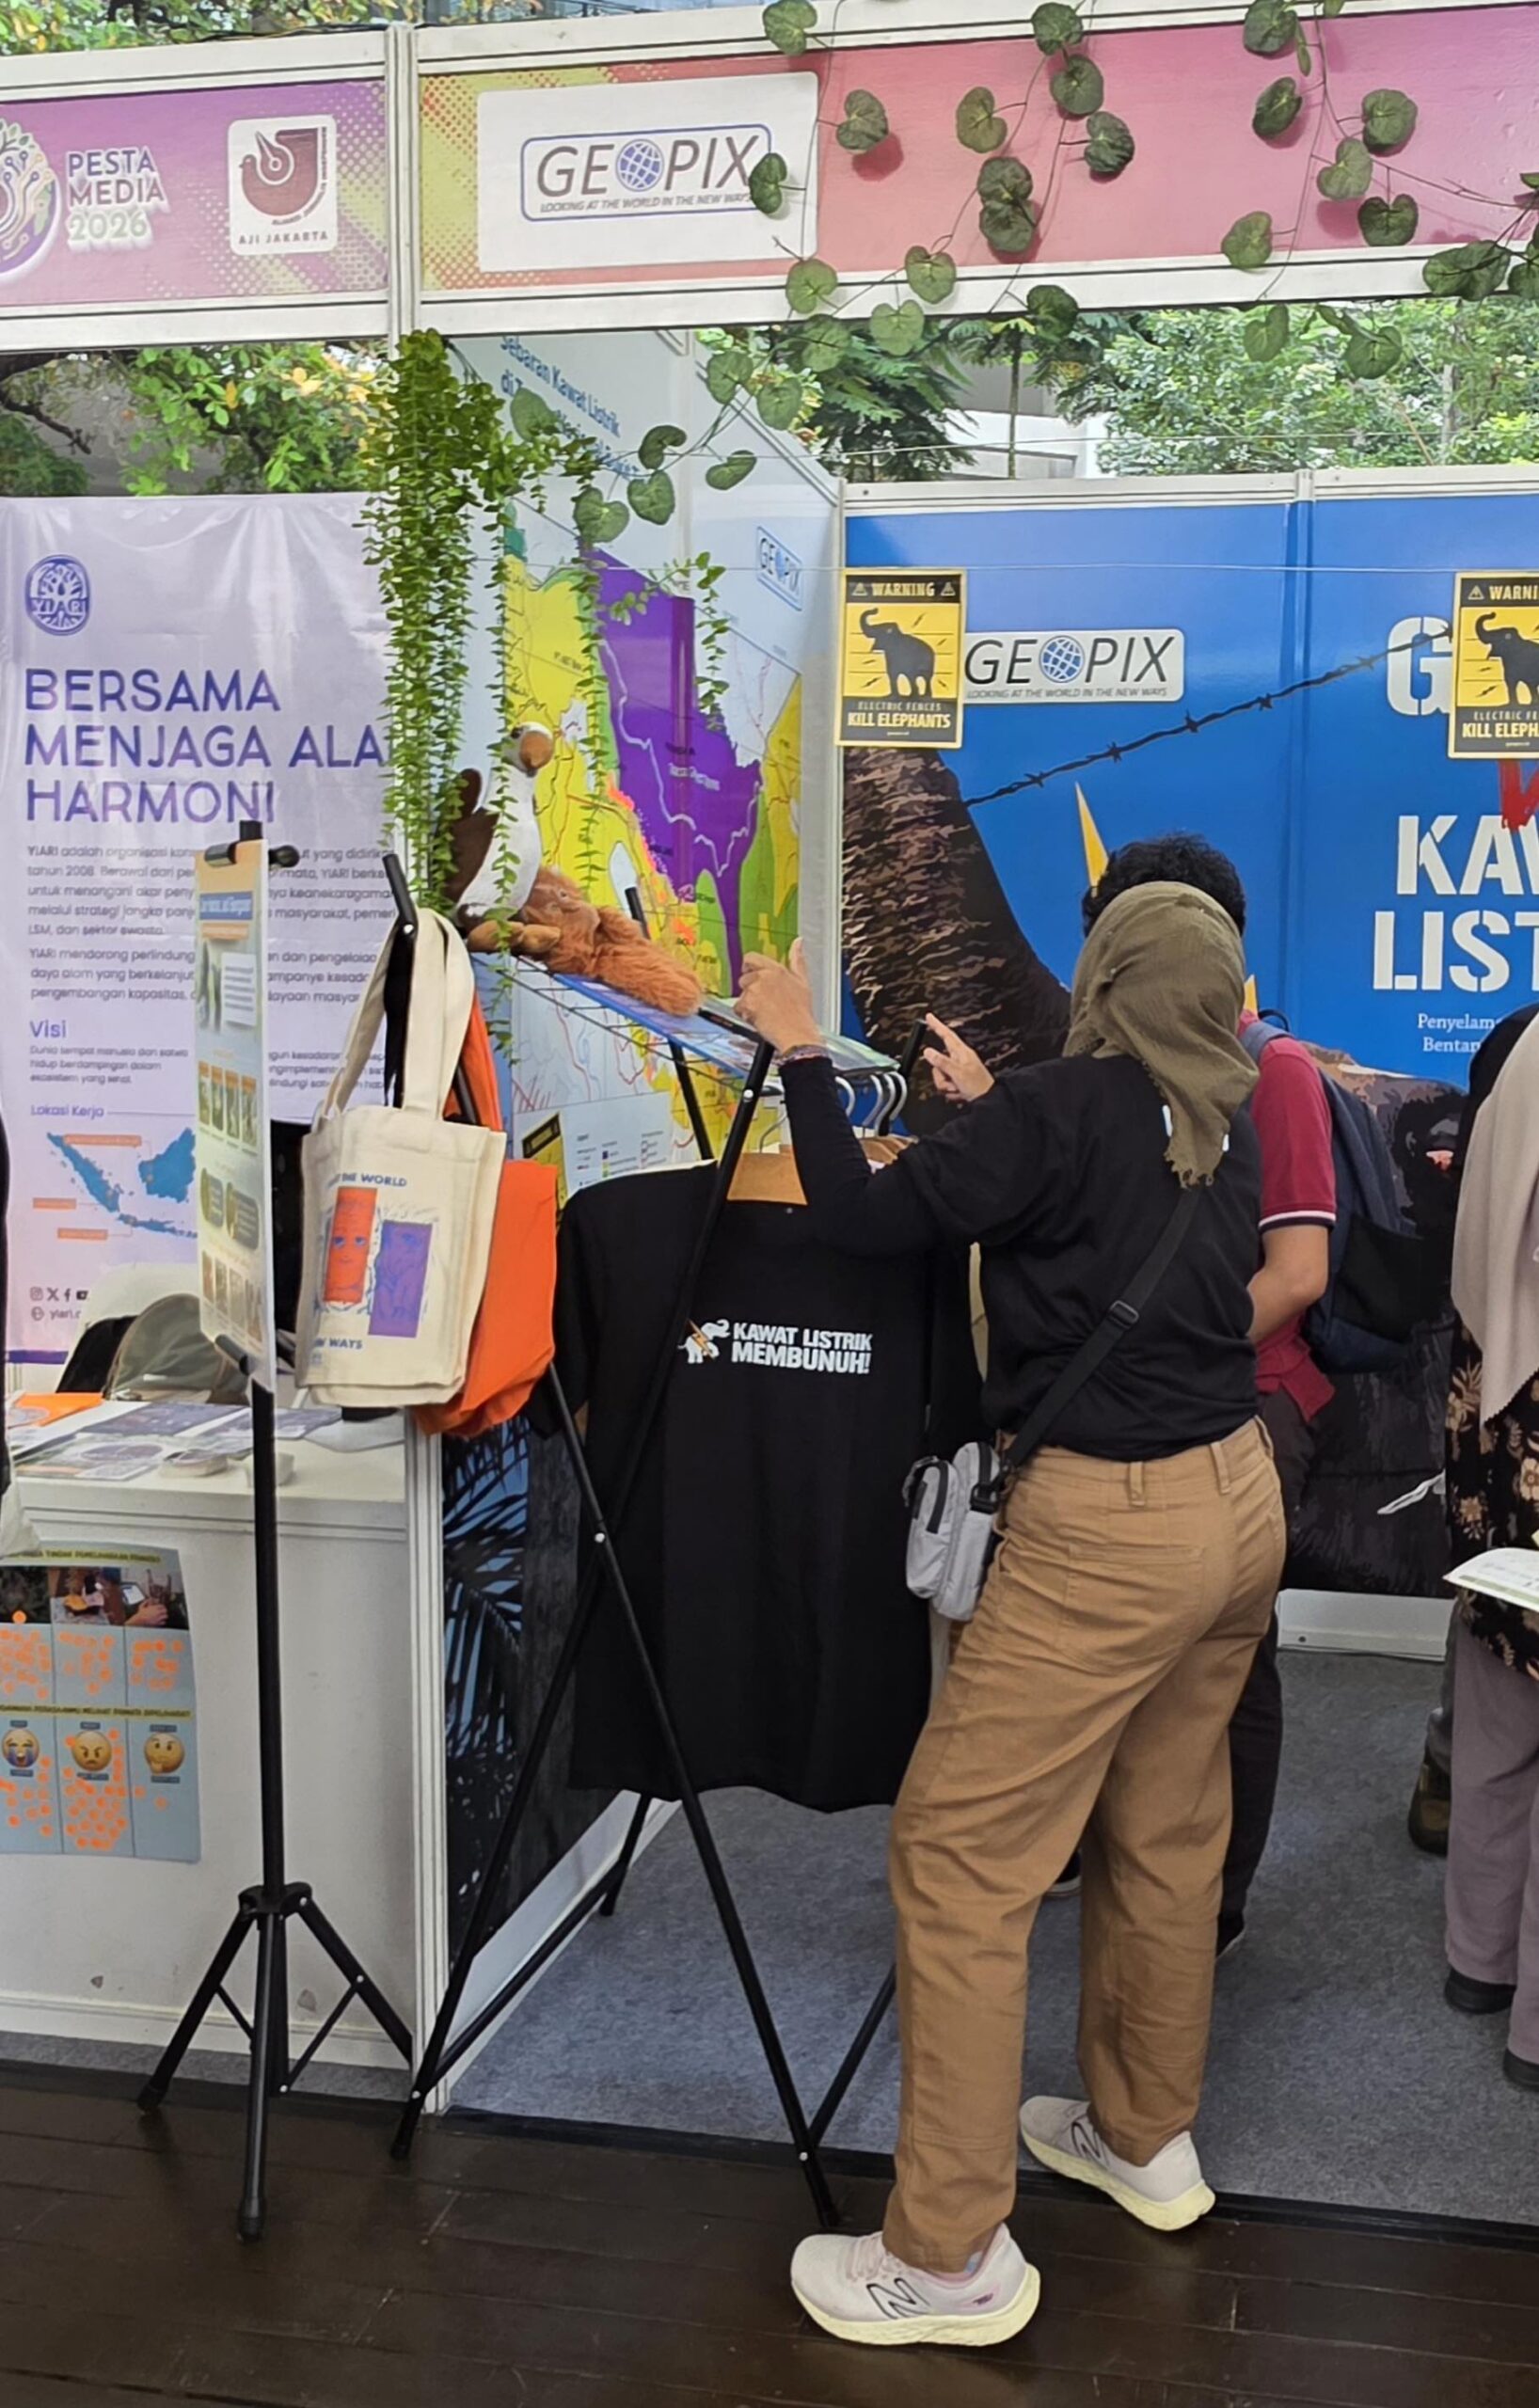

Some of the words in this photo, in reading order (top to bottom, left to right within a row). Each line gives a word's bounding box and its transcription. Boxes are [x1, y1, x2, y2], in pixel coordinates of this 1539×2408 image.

[69, 150, 156, 178] PESTA
[68, 179, 166, 208] MEDIA
[586, 199, 600, 211] AT
[601, 198, 620, 210] THE
[622, 197, 660, 209] WORLD
[70, 210, 148, 241] 2026
[266, 230, 327, 245] JAKARTA
[552, 364, 587, 413] Kawat
[871, 581, 935, 596] WARNING
[1489, 585, 1539, 600] WARNI
[964, 635, 1175, 685] GEOPIX
[24, 669, 281, 712] BERSAMA
[1009, 688, 1023, 698] AT
[1024, 688, 1042, 698] THE
[1045, 688, 1081, 698] WORLD
[1082, 688, 1093, 698] IN
[1095, 688, 1113, 698] THE
[1115, 687, 1138, 697] NEW
[1141, 687, 1166, 697] WAYS
[857, 700, 903, 710] ELECTRIC
[906, 701, 941, 711] FENCES
[848, 711, 875, 727] KILL
[877, 712, 951, 728] ELEPHANTS
[1473, 710, 1521, 721] ELECTRIC
[1526, 710, 1539, 721] FE
[1462, 722, 1492, 738] KILL
[1495, 722, 1539, 738] ELEPH
[24, 723, 272, 768] MENJAGA
[288, 724, 386, 768] ALA
[26, 779, 275, 824] HARMONI
[61, 846, 103, 858] adalah
[105, 846, 167, 861] organisasi
[313, 848, 343, 863] yang
[27, 865, 63, 877] tahun
[100, 866, 149, 878] Berawal
[151, 867, 175, 878] dari
[27, 884, 61, 896] untuk
[64, 885, 134, 899] menangani
[135, 886, 162, 897] akar
[27, 904, 72, 915] melalui
[74, 905, 120, 919] strategi
[121, 905, 164, 920] jangka
[56, 925, 80, 936] dan
[82, 925, 118, 935] sektor
[58, 948, 129, 963] mendorong
[281, 951, 308, 963] dan
[30, 967, 59, 981] daya
[61, 968, 94, 978] alam
[96, 970, 126, 982] yang
[30, 990, 126, 1001] pengembangan
[29, 1020, 67, 1038] Visi
[137, 1047, 158, 1057] dan
[81, 1074, 105, 1085] yang
[30, 1104, 70, 1117] Lokasi
[71, 1105, 104, 1119] Kerja
[360, 1174, 407, 1188] WORLD
[329, 1338, 363, 1351] WAYS
[732, 1322, 799, 1345] KAWAT
[801, 1327, 873, 1352] LISTRIK
[731, 1340, 872, 1375] MEMBUNUH!
